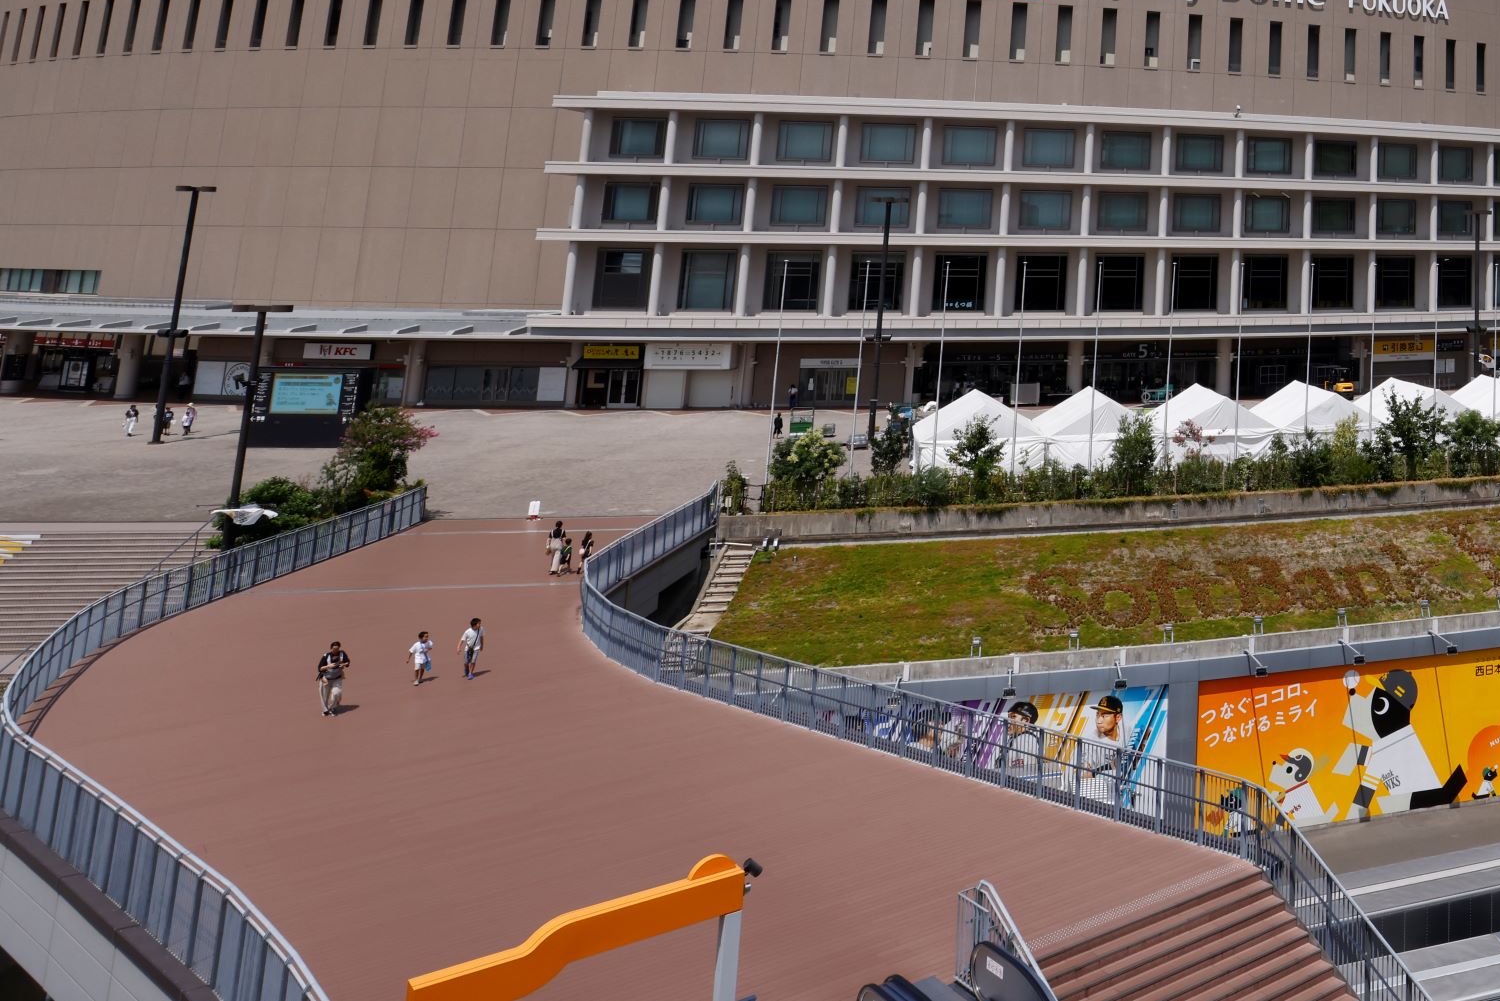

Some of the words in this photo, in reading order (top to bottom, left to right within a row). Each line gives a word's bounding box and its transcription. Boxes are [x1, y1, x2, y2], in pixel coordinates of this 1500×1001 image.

[334, 347, 358, 356] KFC
[1138, 344, 1148, 359] 5
[1201, 683, 1309, 725] つなぐココロ、
[1204, 698, 1318, 748] つなげるミライ
[1384, 775, 1401, 790] WKS
